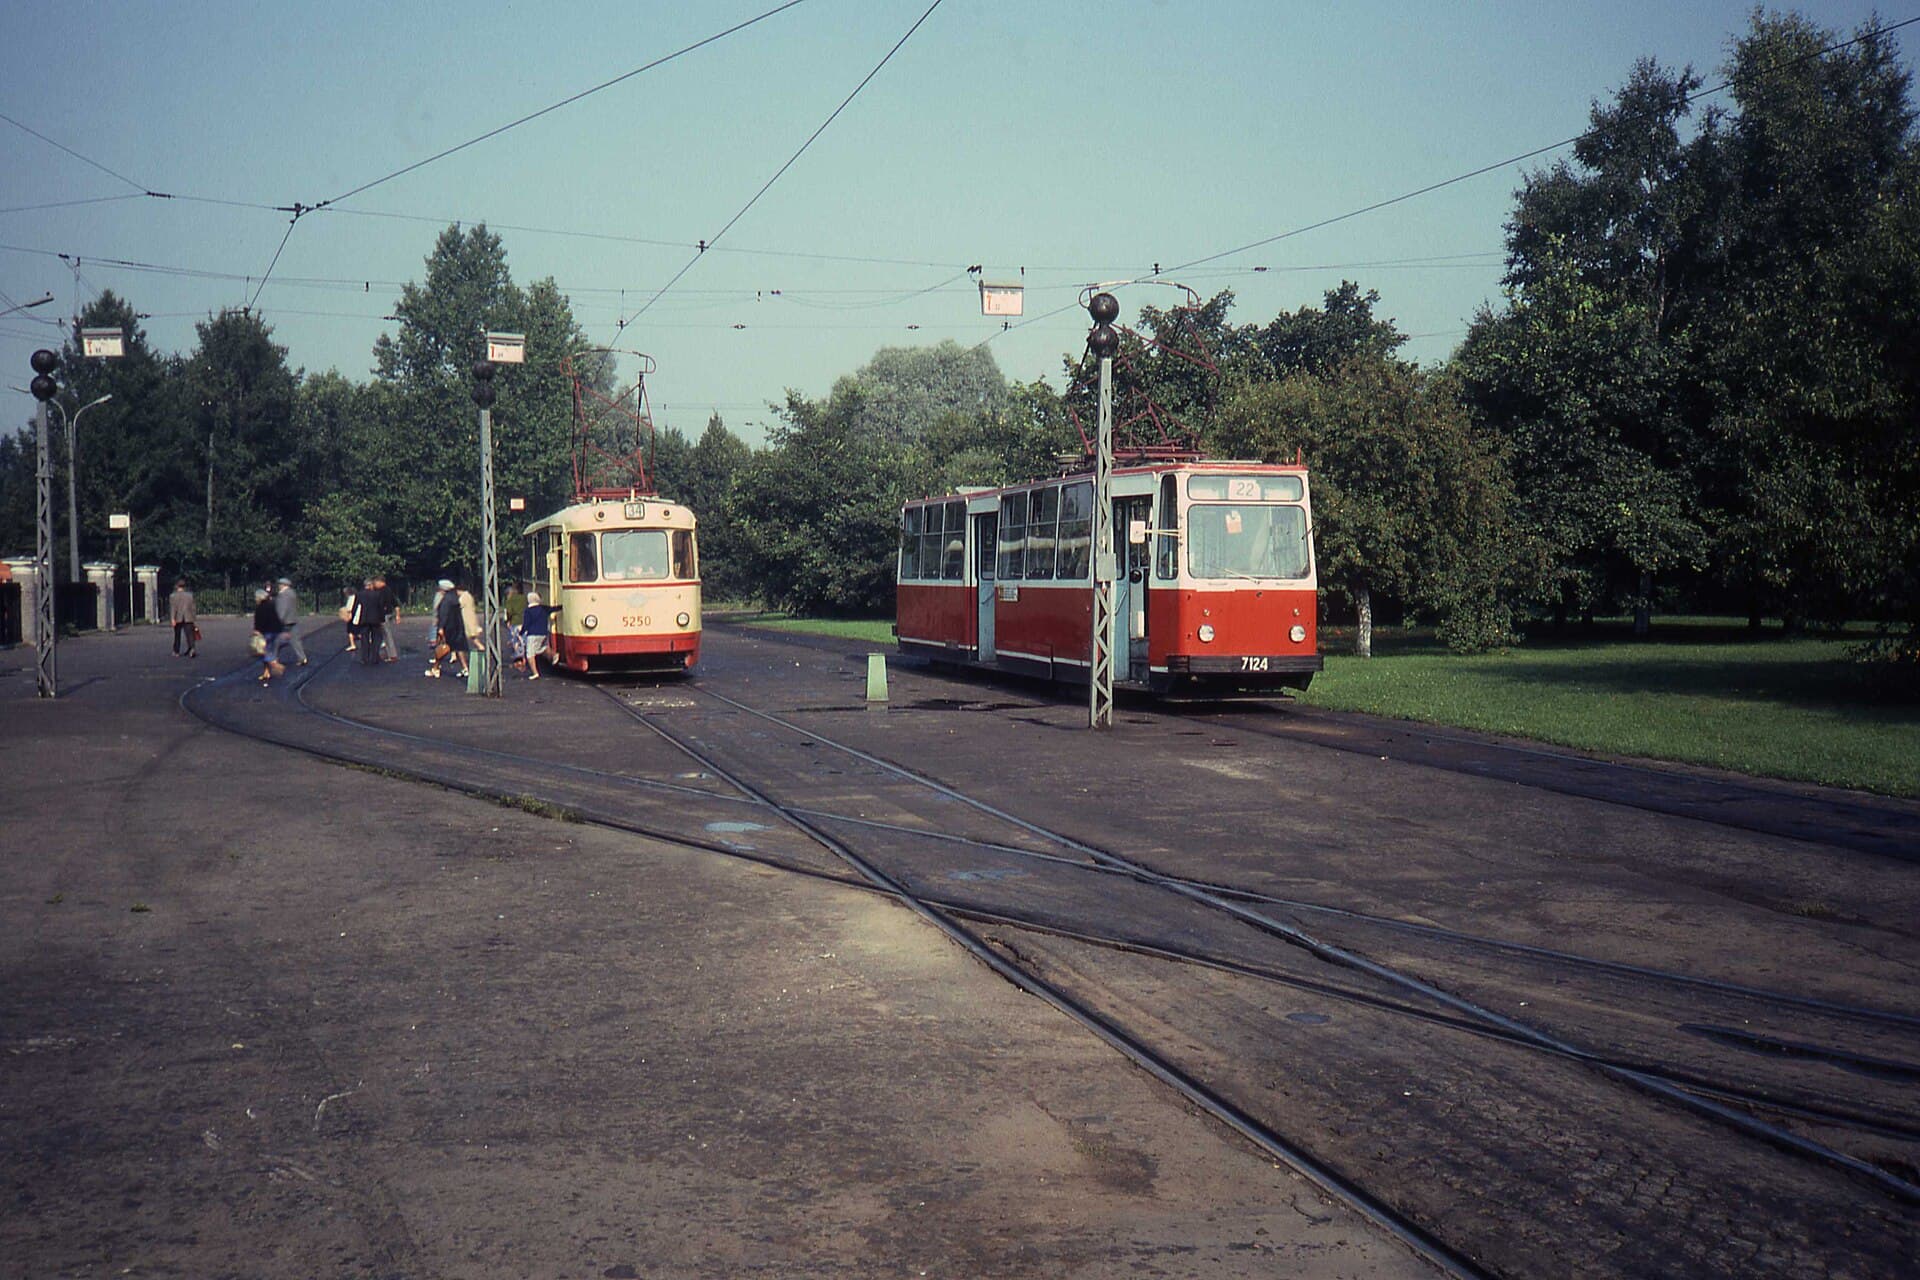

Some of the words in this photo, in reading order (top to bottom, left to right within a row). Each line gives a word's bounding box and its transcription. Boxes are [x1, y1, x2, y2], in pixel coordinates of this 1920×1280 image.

[1236, 482, 1254, 497] 22
[622, 615, 652, 627] 5250
[1241, 656, 1268, 671] 7124
